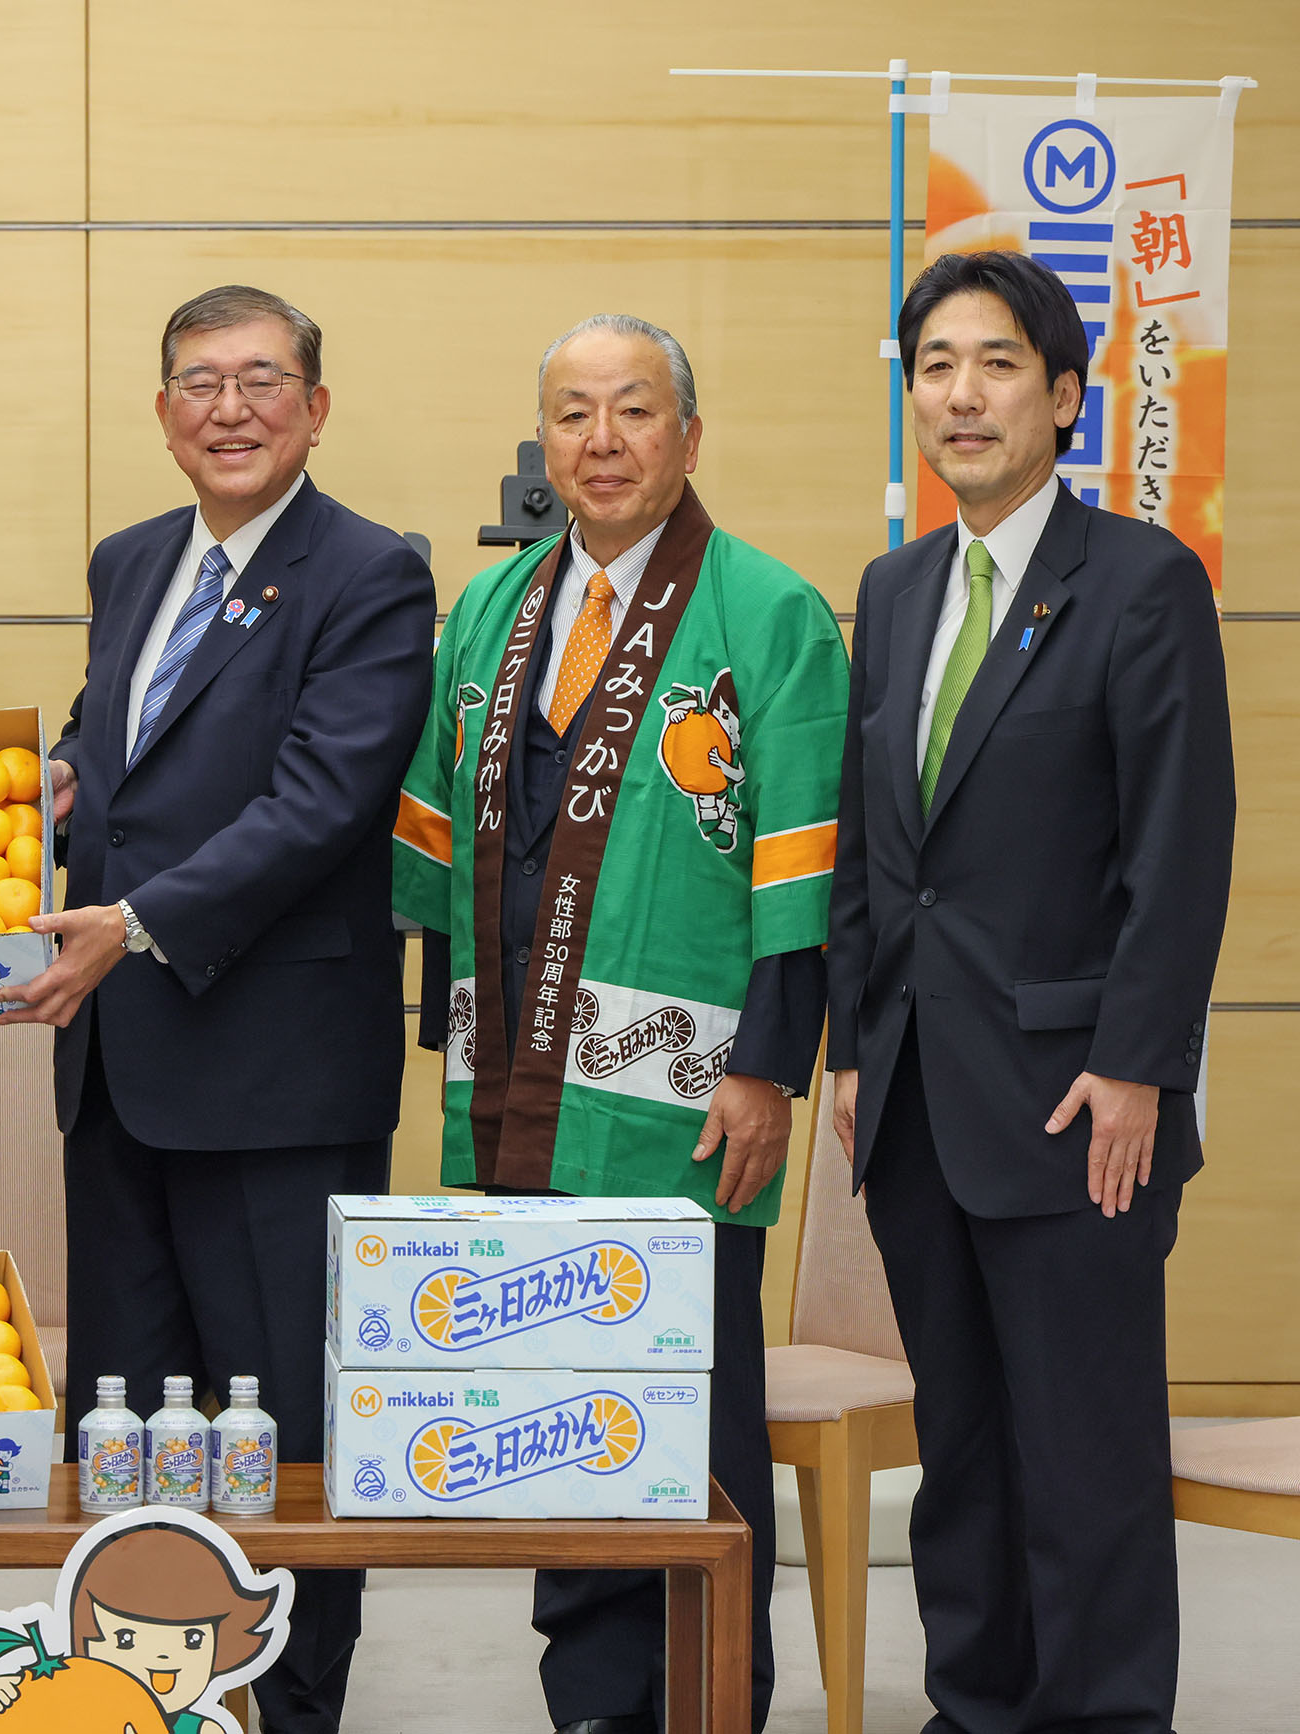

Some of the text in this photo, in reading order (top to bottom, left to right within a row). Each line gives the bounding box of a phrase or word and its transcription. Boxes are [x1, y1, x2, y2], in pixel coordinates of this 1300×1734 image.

[1125, 173, 1200, 527] 「朝」をいただき
[567, 582, 677, 824] JAみっかび
[530, 873, 581, 1052] 女性部50周年記念
[392, 1240, 460, 1258] mikkabi
[467, 1238, 505, 1258] 青島
[651, 1238, 701, 1252] 光センサー
[387, 1391, 454, 1408] mikkabi
[463, 1389, 500, 1407] 青島
[646, 1388, 697, 1402] 光センサー
